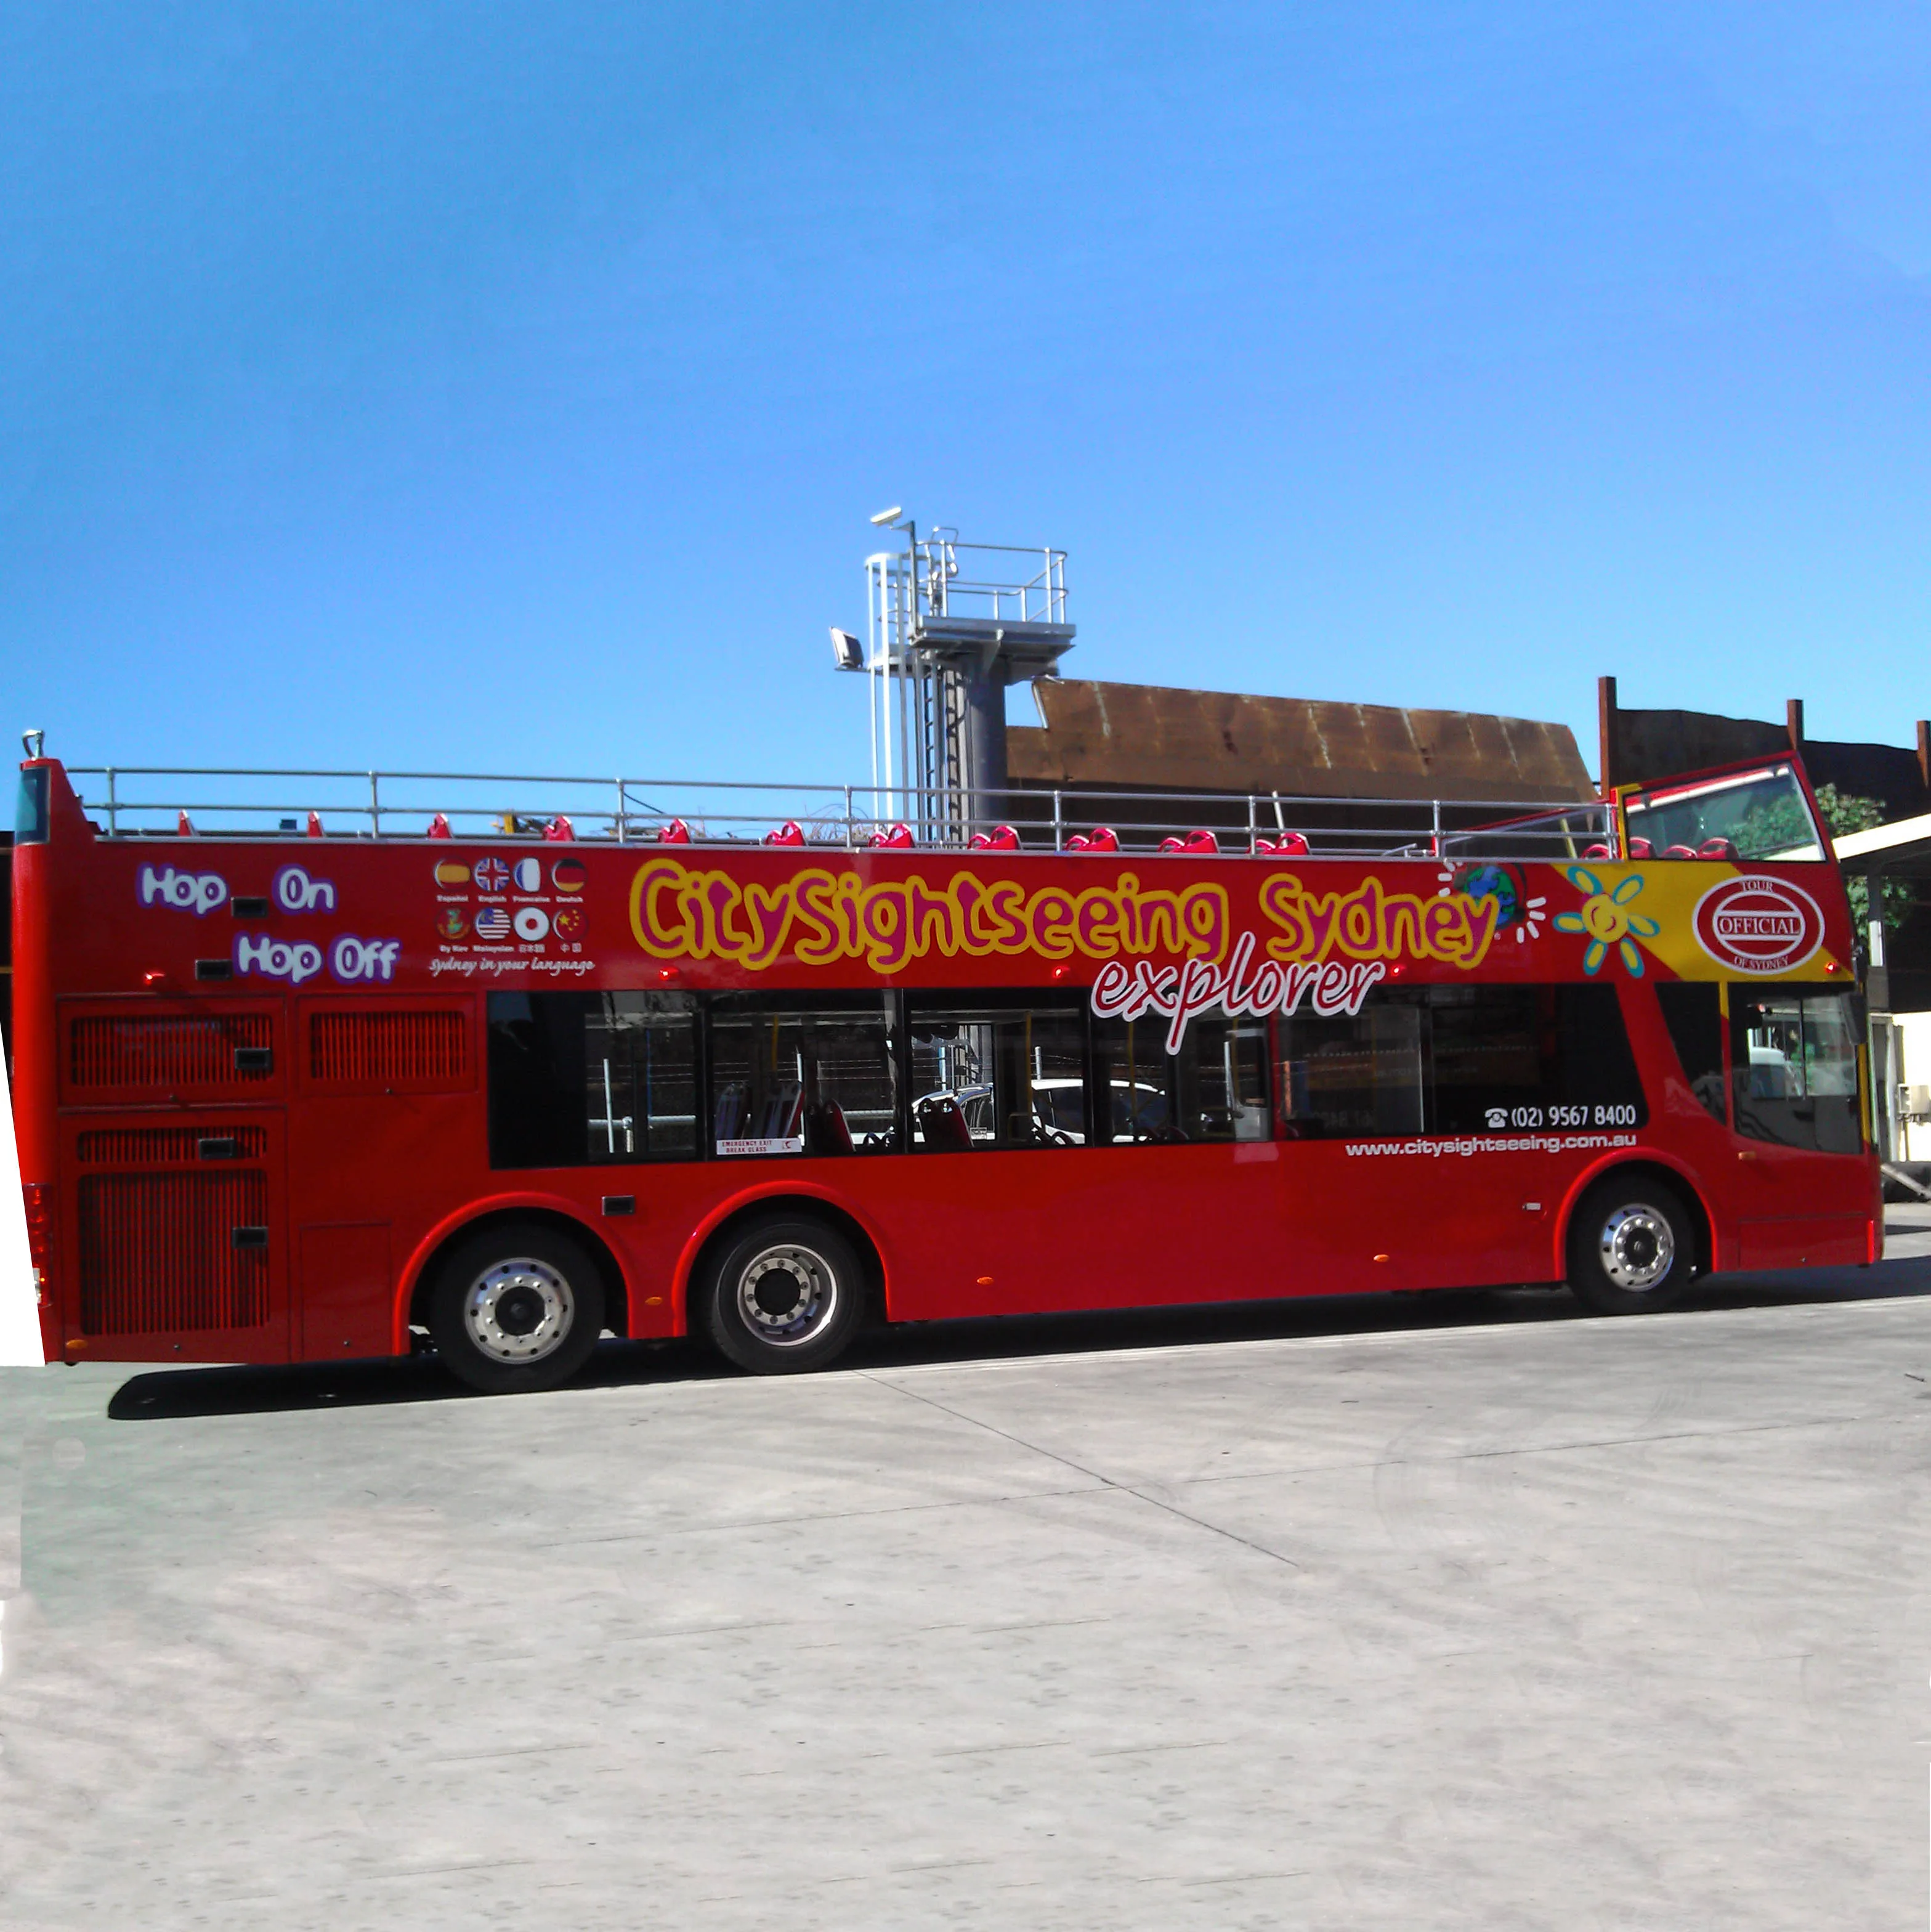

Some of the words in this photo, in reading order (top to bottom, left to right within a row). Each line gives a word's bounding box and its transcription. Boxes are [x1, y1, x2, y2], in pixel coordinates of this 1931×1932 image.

[140, 866, 228, 915] Hop
[277, 867, 336, 912] On
[1741, 880, 1774, 893] TOUR
[1259, 872, 1500, 970] Sydney
[1719, 917, 1799, 935] OFFICIAL
[237, 935, 323, 984] Hop
[333, 936, 402, 980] Off
[493, 960, 530, 978] your
[530, 956, 596, 977] language
[1733, 956, 1746, 967] OF
[1746, 956, 1789, 970] SYDNEY
[1090, 931, 1387, 1056] explorer
[1510, 1106, 1544, 1128] (02)
[1548, 1105, 1589, 1127] 9567
[1593, 1104, 1637, 1126] 8400
[1345, 1134, 1637, 1158] www.citysightseeing.com.au
